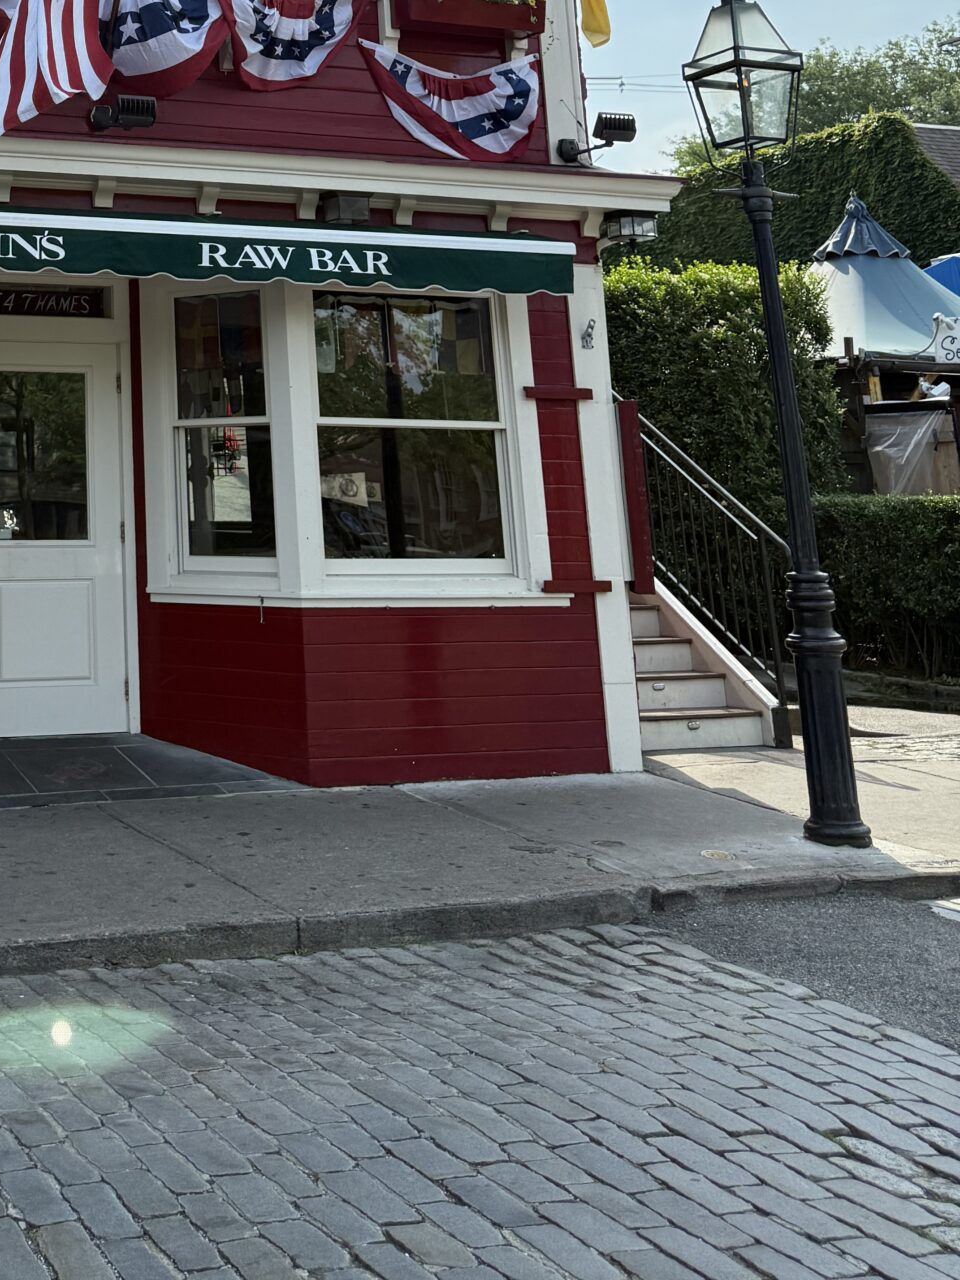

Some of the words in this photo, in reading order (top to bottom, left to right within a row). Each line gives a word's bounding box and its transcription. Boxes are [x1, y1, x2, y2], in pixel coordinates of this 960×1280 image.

[197, 242, 296, 270] RAW
[306, 247, 392, 276] BAR
[21, 293, 90, 314] THAMES
